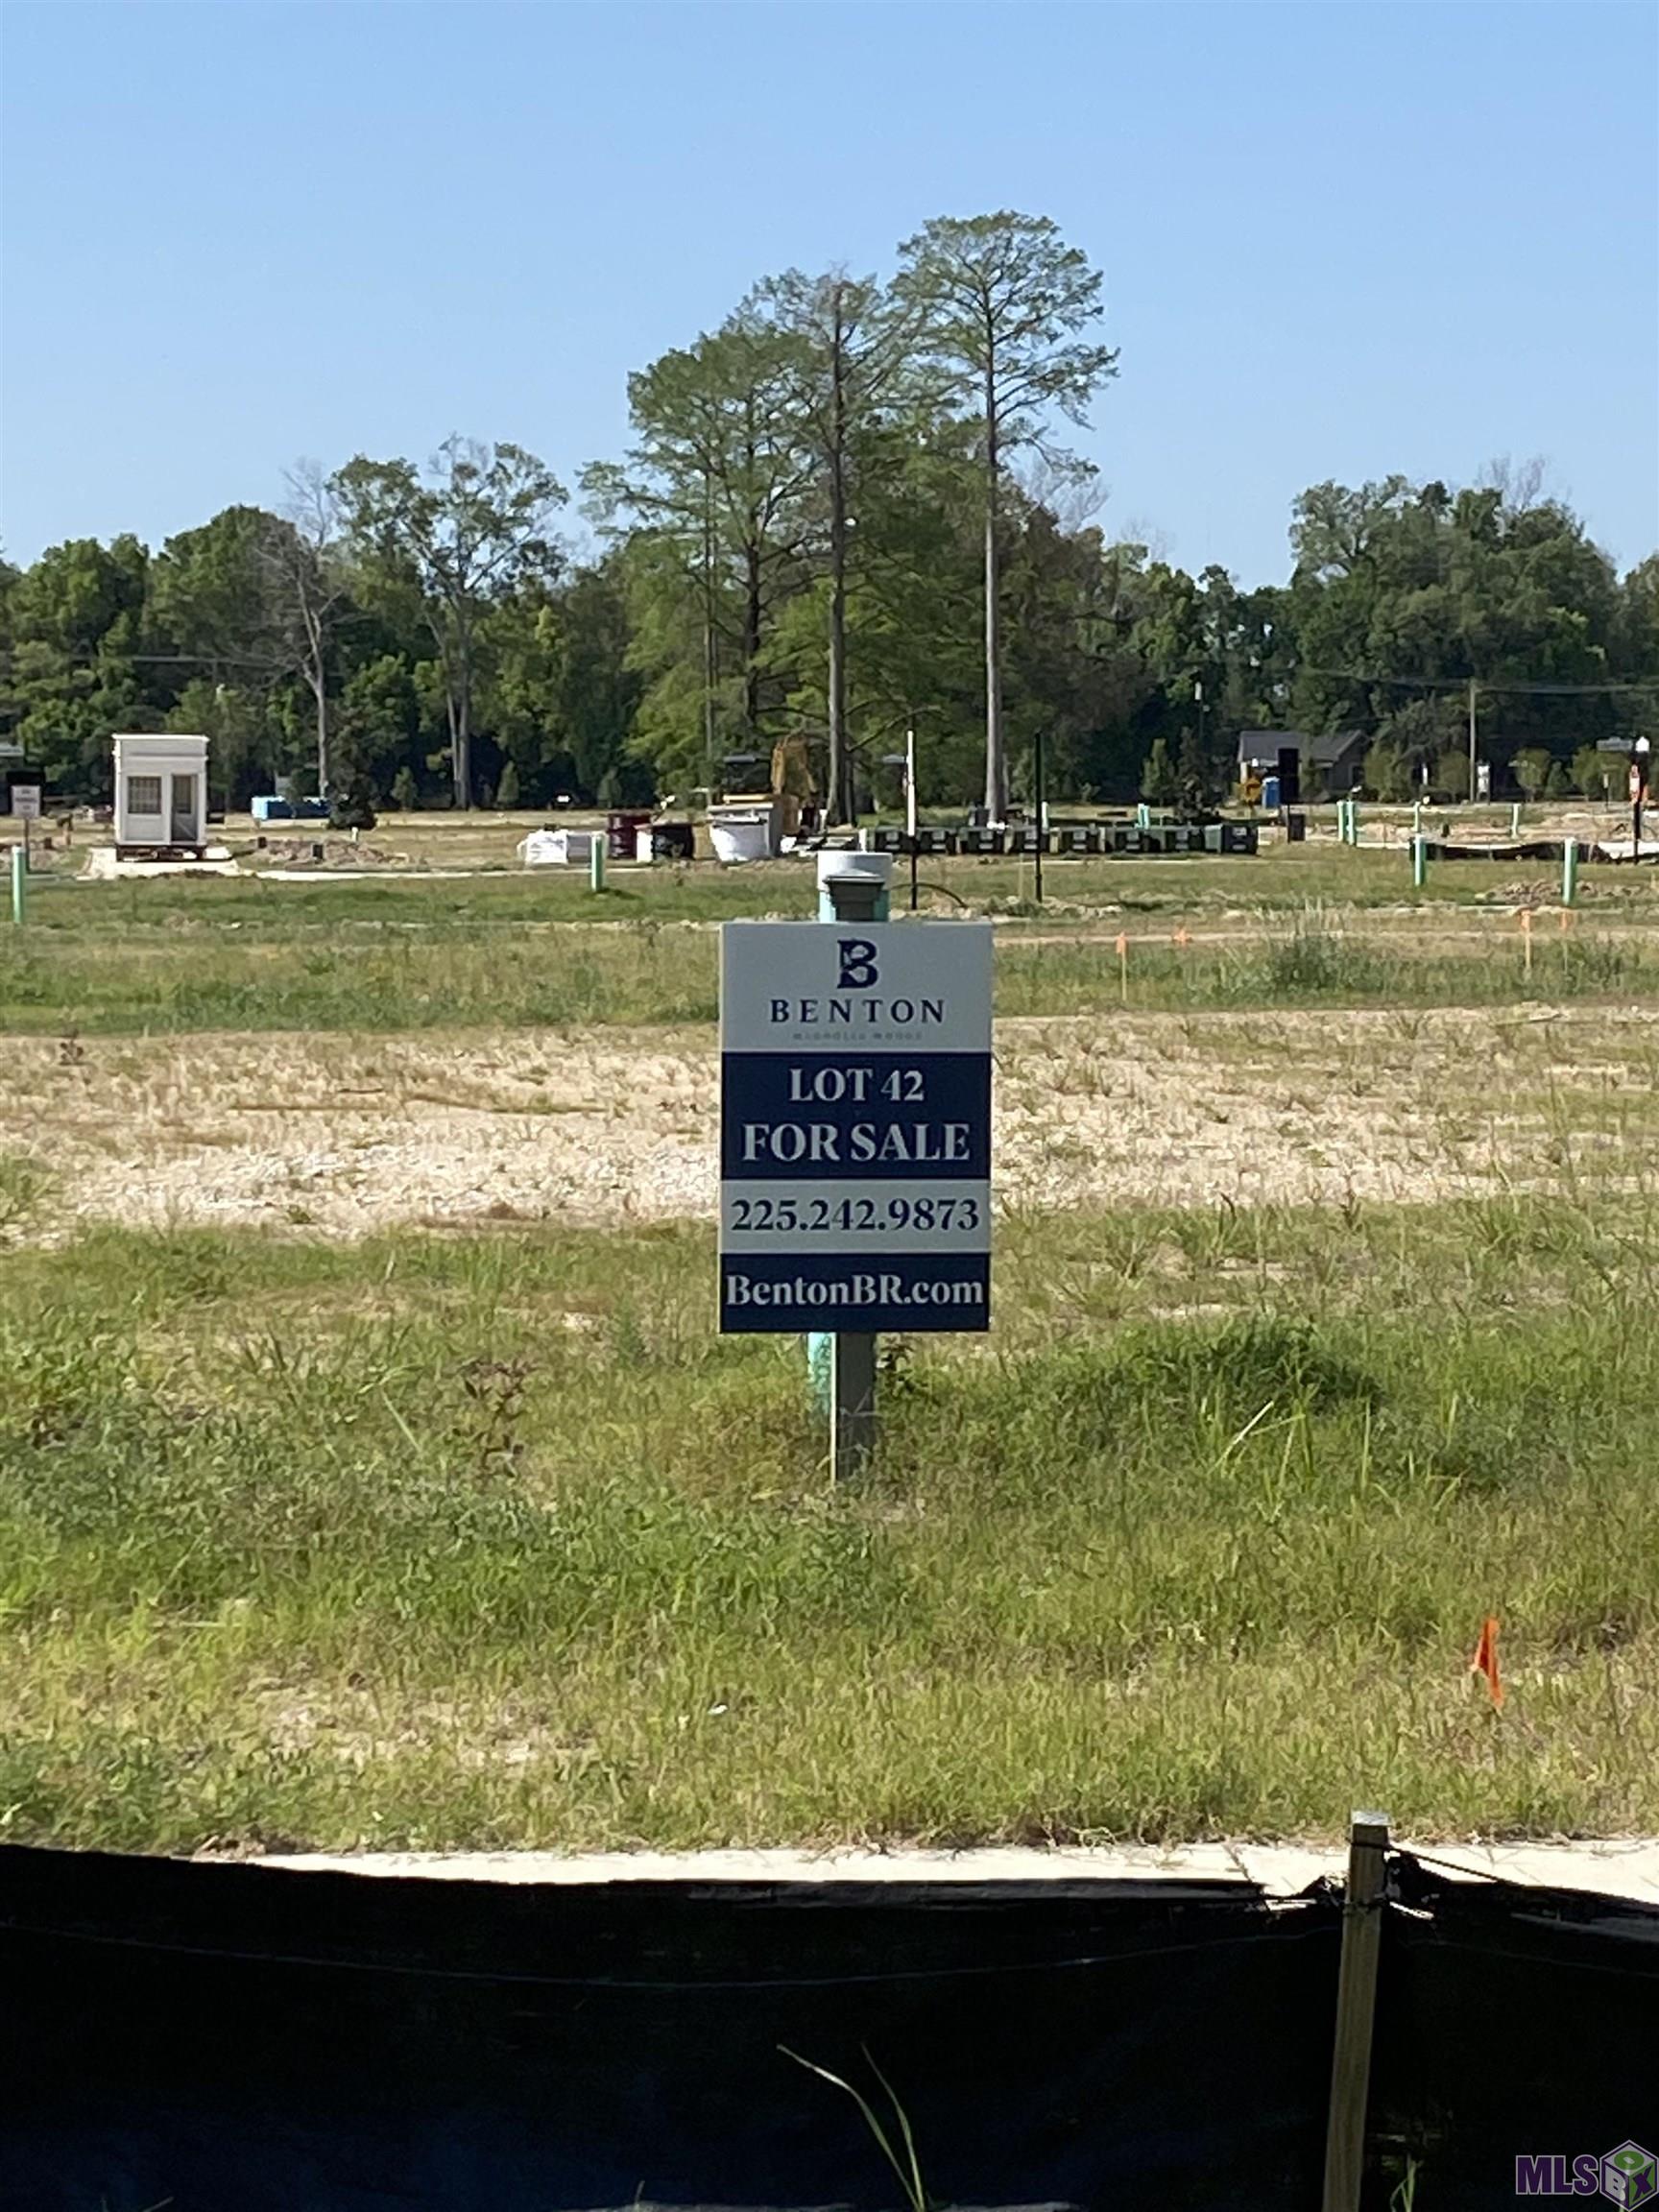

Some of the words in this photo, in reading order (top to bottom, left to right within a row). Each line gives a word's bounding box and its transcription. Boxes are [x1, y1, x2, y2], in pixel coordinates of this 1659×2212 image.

[770, 999, 945, 1022] BENTON
[789, 1068, 873, 1101] LOT
[880, 1070, 925, 1101] 42
[742, 1123, 841, 1161] FOR
[851, 1123, 970, 1161] SALE
[731, 1198, 979, 1231] 225.242.9873
[726, 1274, 984, 1306] BentonBR.com
